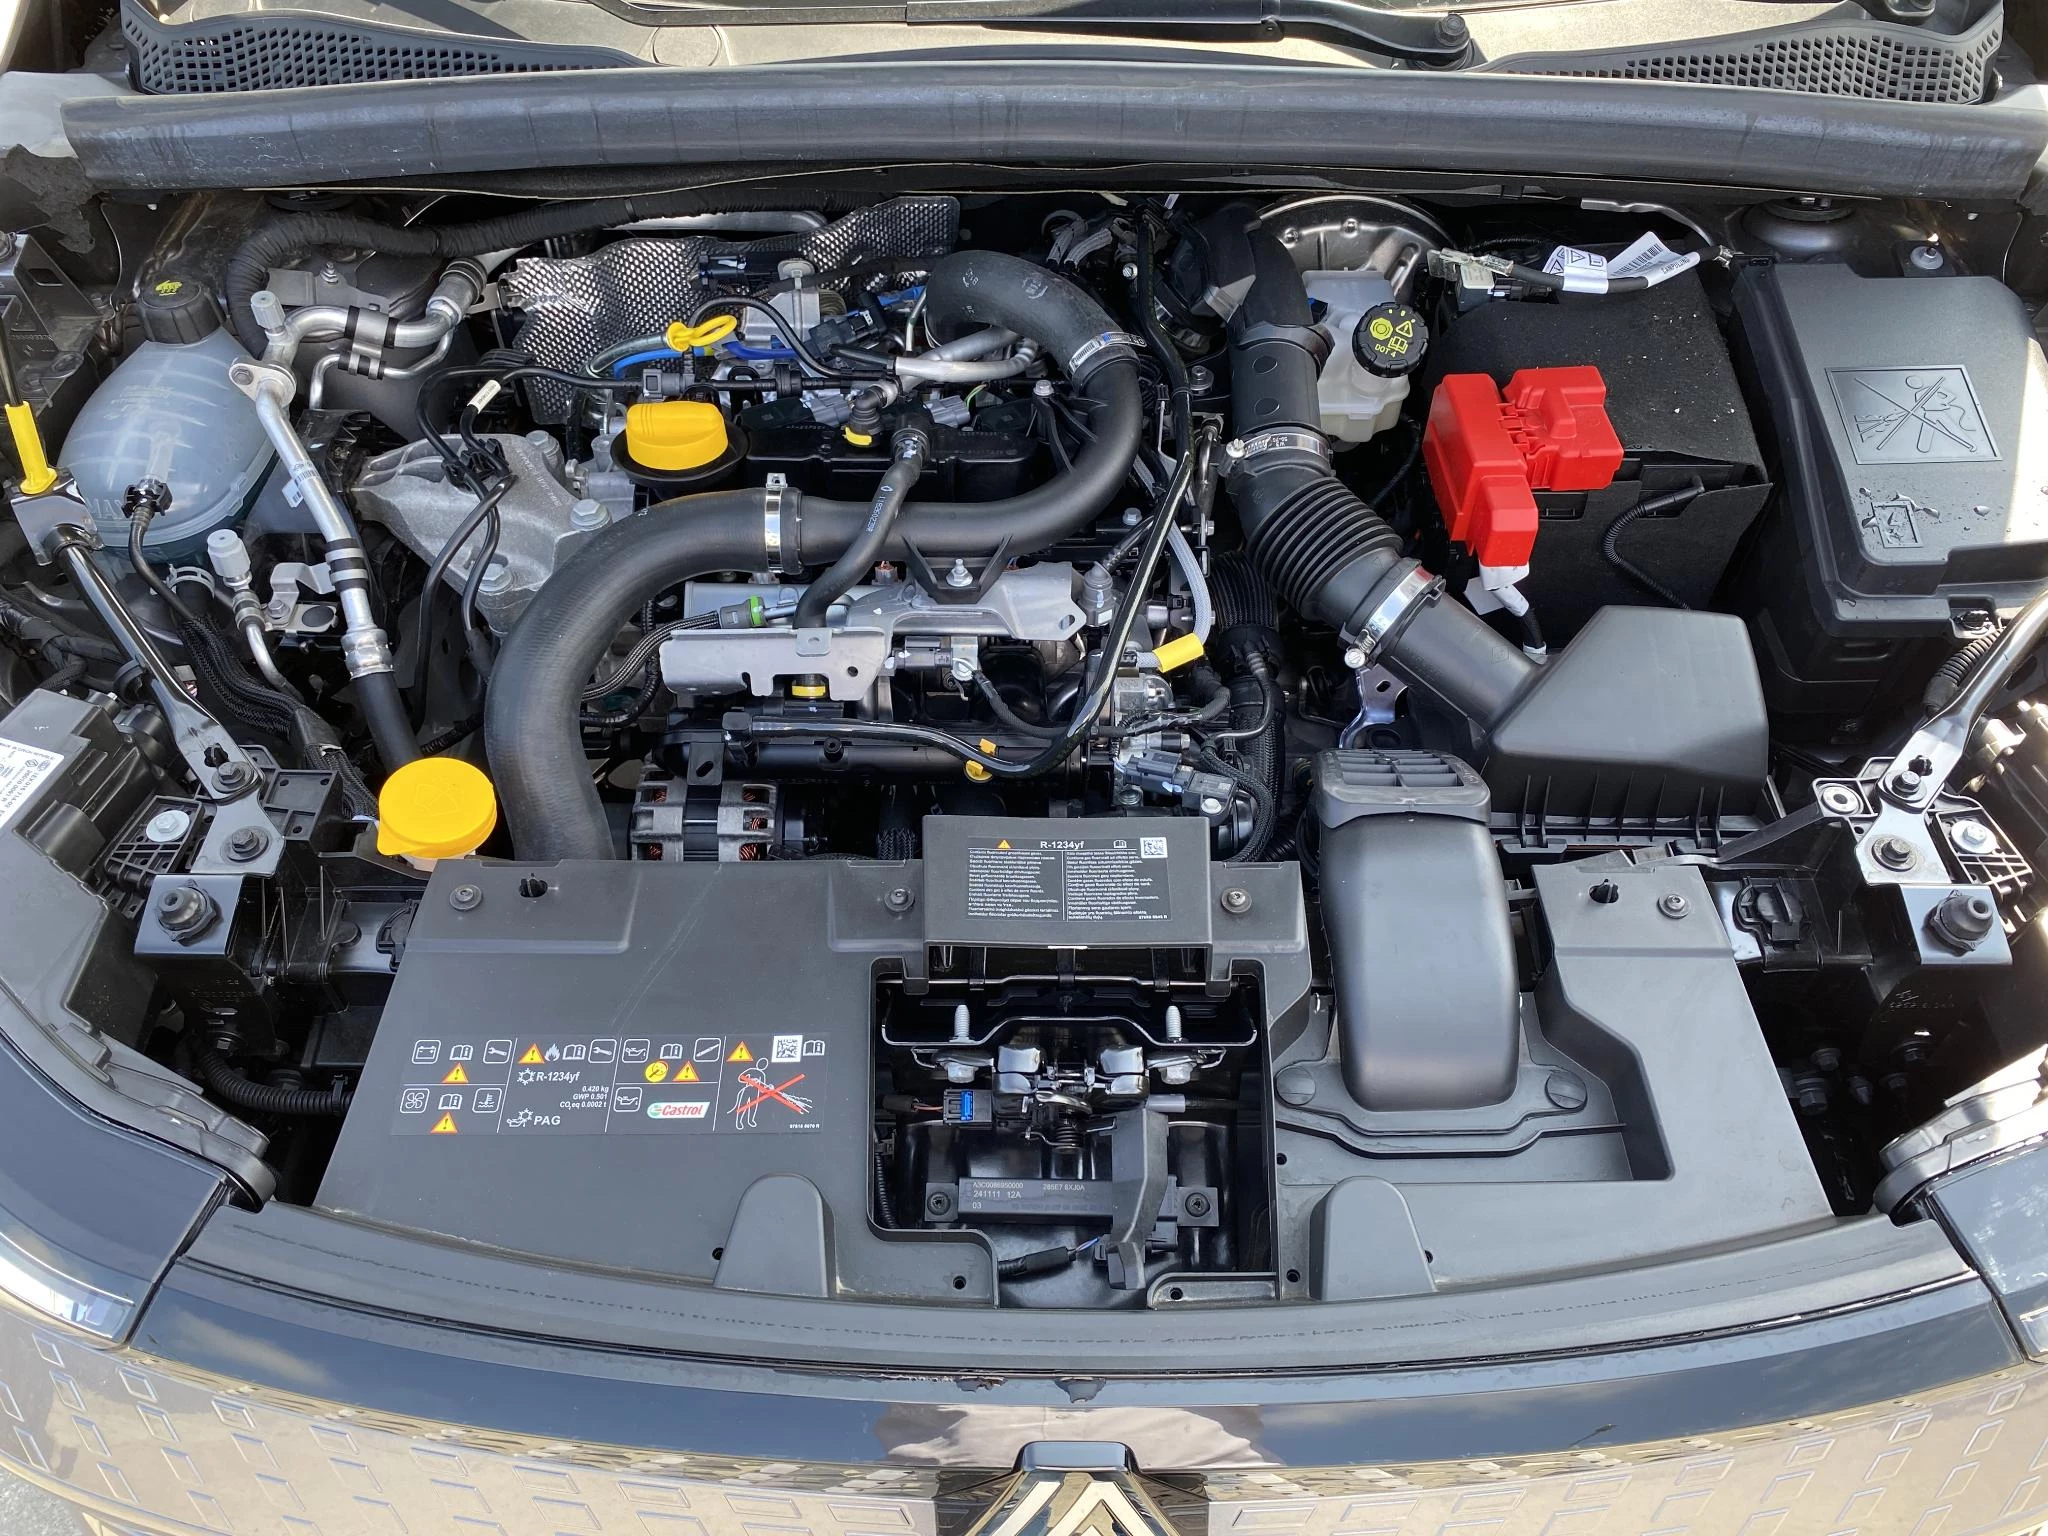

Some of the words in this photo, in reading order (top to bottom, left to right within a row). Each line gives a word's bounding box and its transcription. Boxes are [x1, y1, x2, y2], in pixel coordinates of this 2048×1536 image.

[1375, 343, 1390, 355] DOT
[1040, 840, 1084, 850] R-1234yf
[536, 1071, 581, 1084] R-1234yf
[662, 1104, 703, 1116] Castrol
[533, 1115, 561, 1126] PAG
[1007, 1191, 1021, 1199] 12A
